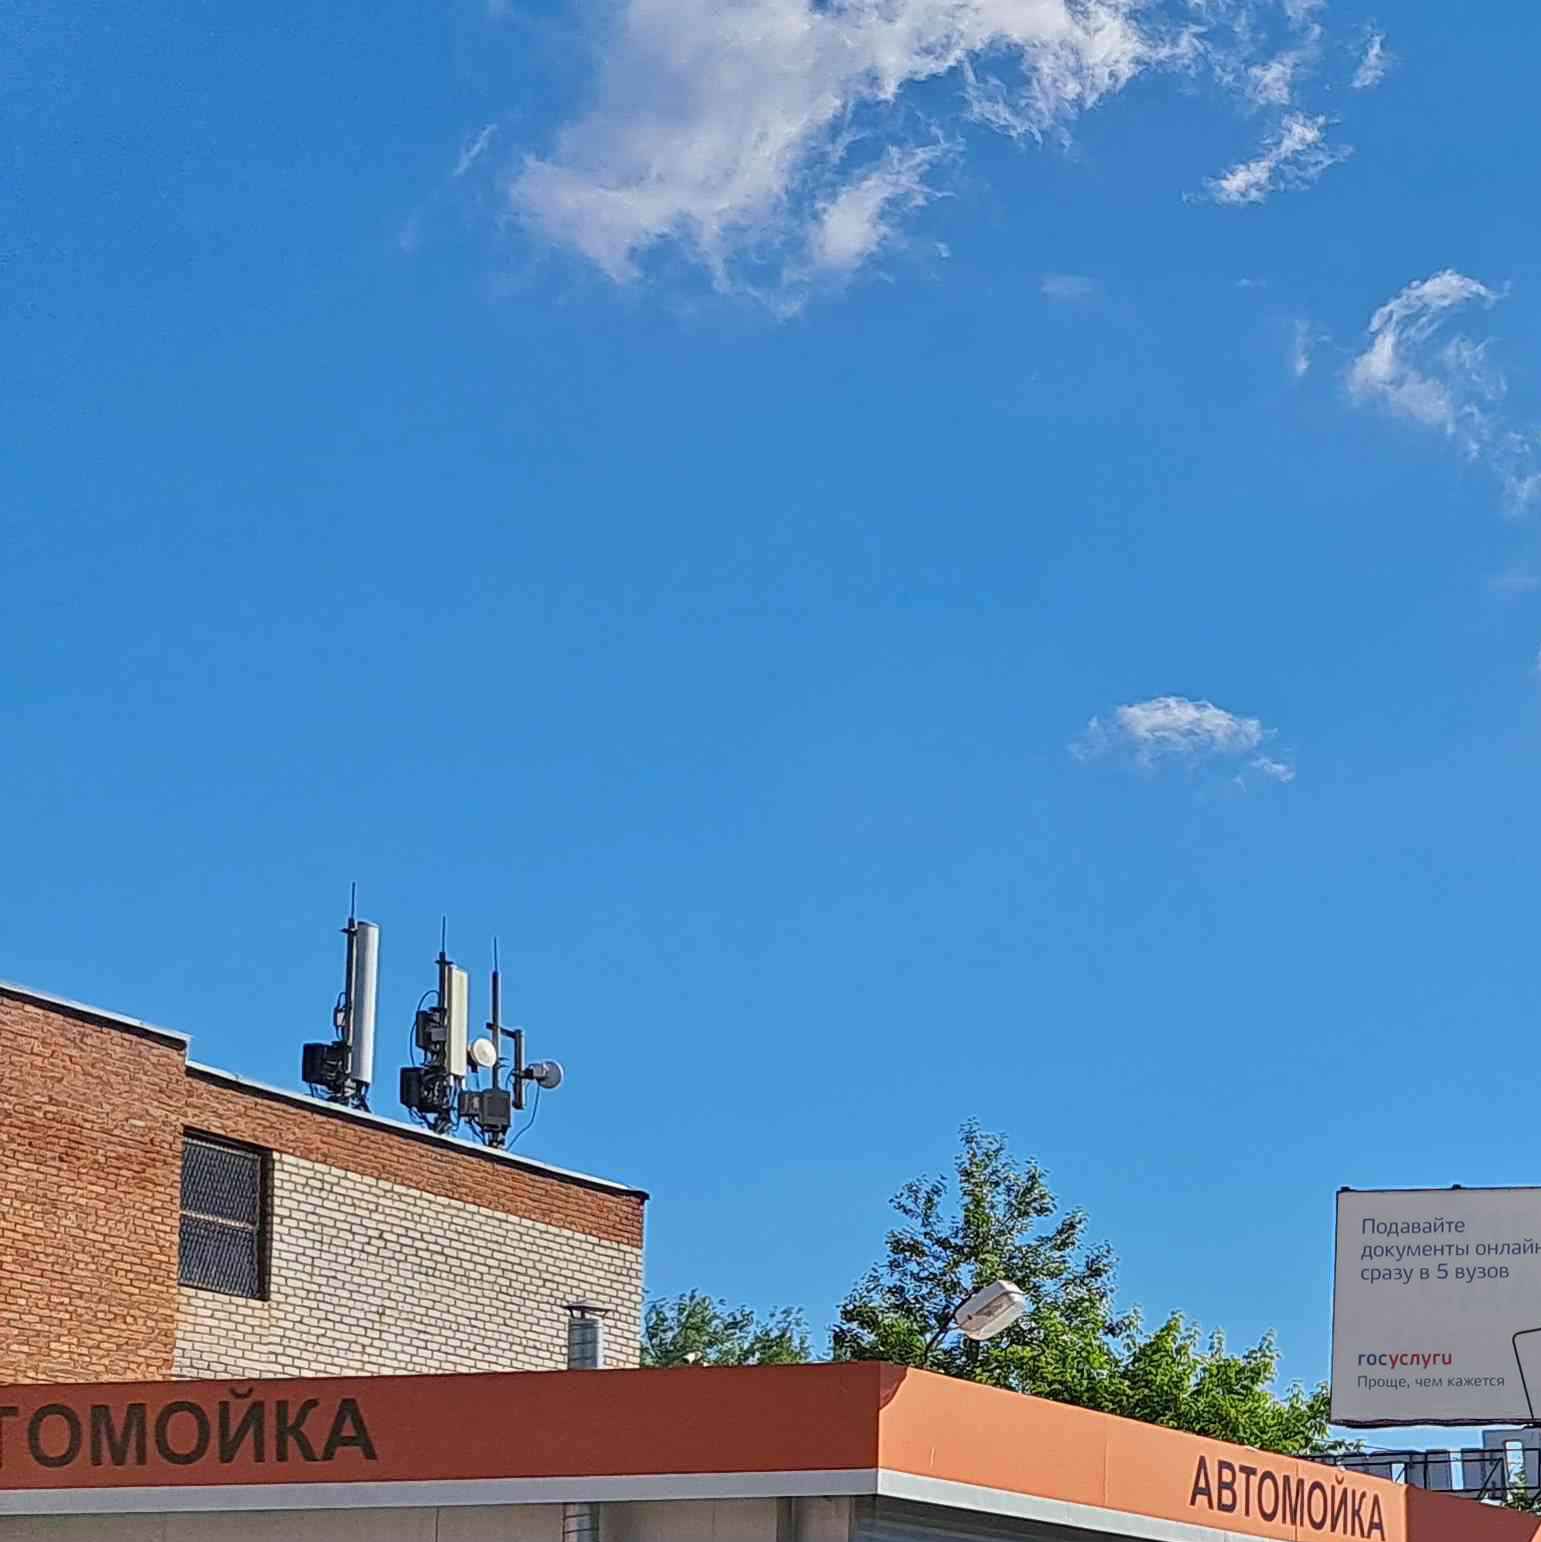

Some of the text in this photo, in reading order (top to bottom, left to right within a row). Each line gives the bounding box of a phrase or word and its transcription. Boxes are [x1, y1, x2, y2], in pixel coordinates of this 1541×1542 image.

[1361, 1217, 1466, 1237] Подавайте
[1360, 1243, 1470, 1261] документы
[1360, 1263, 1511, 1284] сразу в 5 вузов
[1357, 1352, 1453, 1369] госуслуги
[1357, 1375, 1505, 1389] Проще, чем кажется
[1189, 1455, 1386, 1541] АВТОМОЙКА
